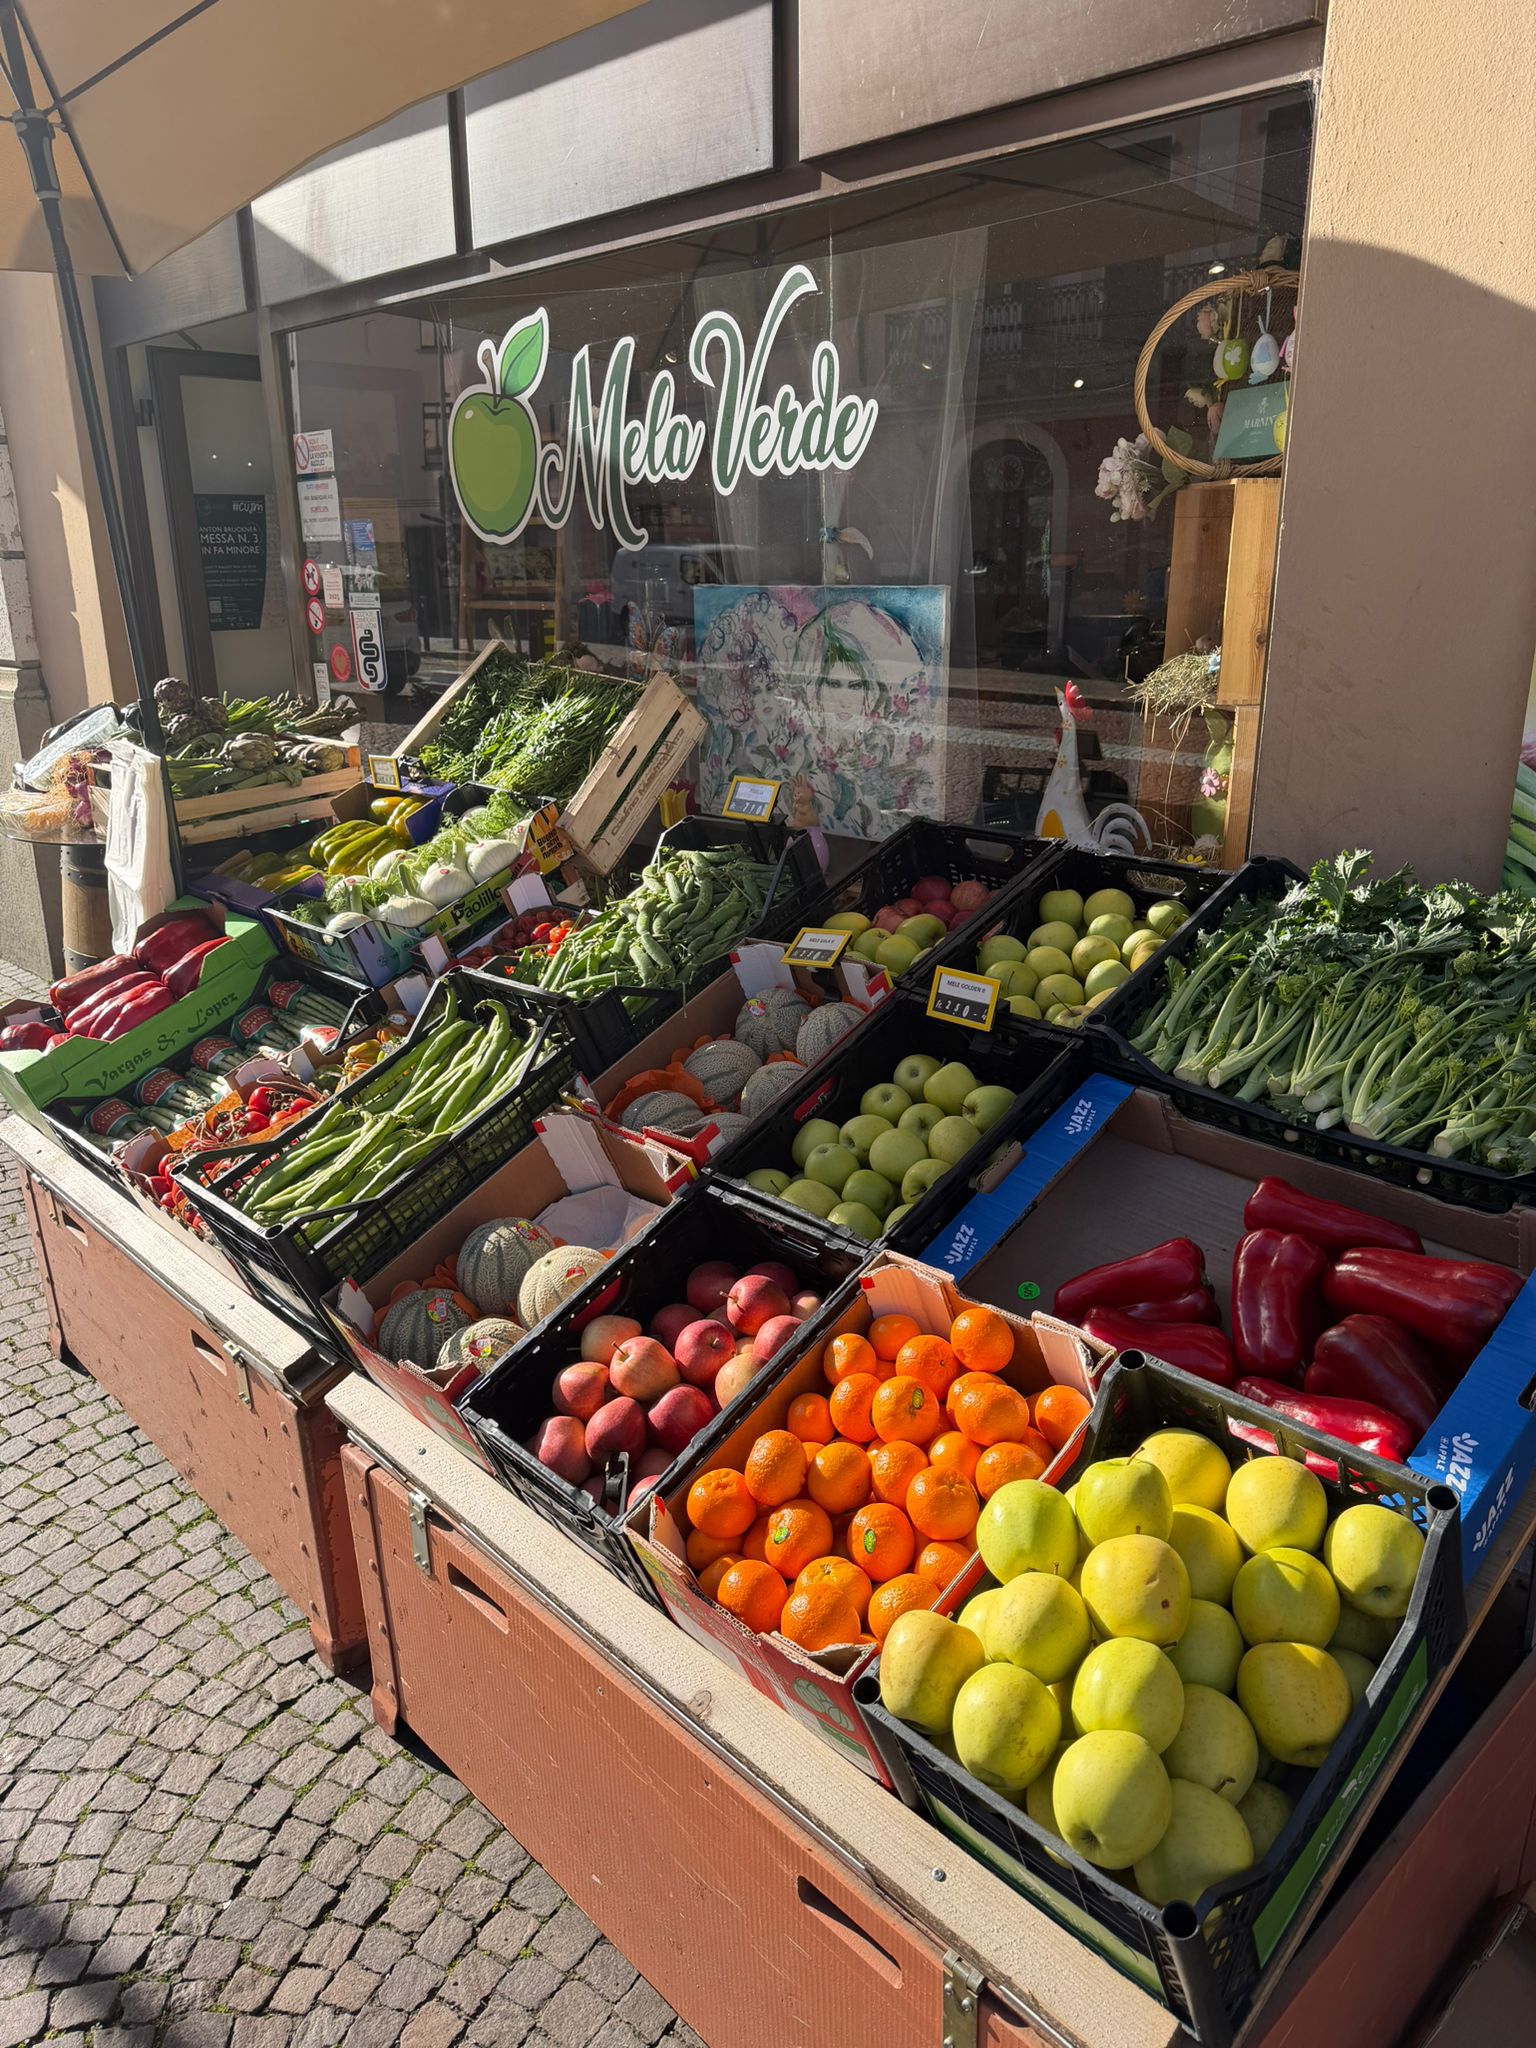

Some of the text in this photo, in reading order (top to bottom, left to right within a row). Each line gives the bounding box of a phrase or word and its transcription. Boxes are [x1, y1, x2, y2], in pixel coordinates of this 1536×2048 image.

[538, 264, 879, 551] Mela Verde
[200, 533, 259, 544] MESSA N. 3
[201, 545, 260, 555] IN FA MINORE
[450, 886, 501, 926] Paolillo
[946, 980, 960, 988] MELE
[960, 983, 981, 992] GOLDEN
[84, 1045, 152, 1091] Vargas
[157, 1030, 180, 1051] &
[187, 991, 240, 1035] Lopez
[1073, 1098, 1093, 1133] JAZZ
[1086, 1109, 1097, 1127] APPLE
[955, 1224, 975, 1263] JAZZ
[968, 1238, 979, 1257] APPLE
[1436, 1443, 1448, 1472] APPLE
[1445, 1435, 1474, 1492] JAZZ
[1478, 1466, 1514, 1548] JAZZ
